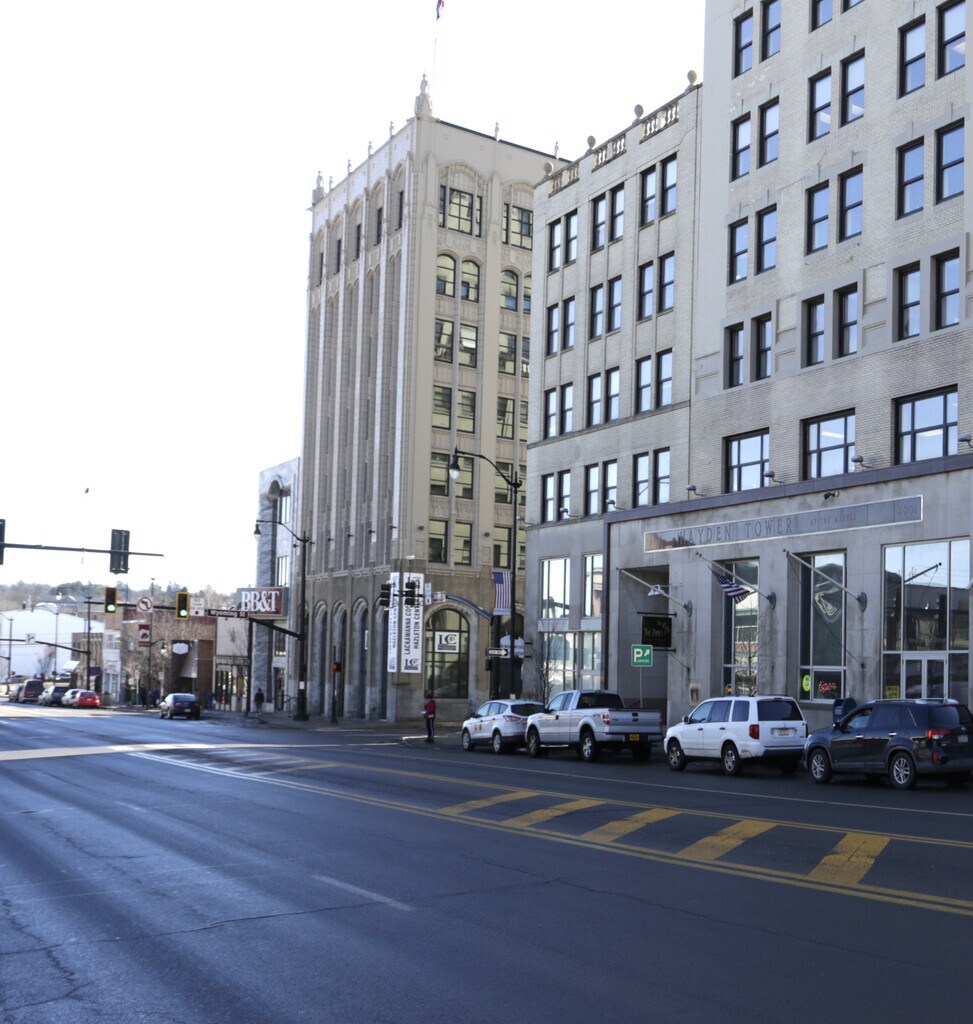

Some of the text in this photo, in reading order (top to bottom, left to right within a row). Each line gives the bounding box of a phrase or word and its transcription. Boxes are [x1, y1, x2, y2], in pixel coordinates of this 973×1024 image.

[678, 524, 731, 544] HAYDEN
[745, 517, 792, 537] TOWER
[241, 590, 279, 612] BB&T
[210, 610, 238, 618] Wyoming
